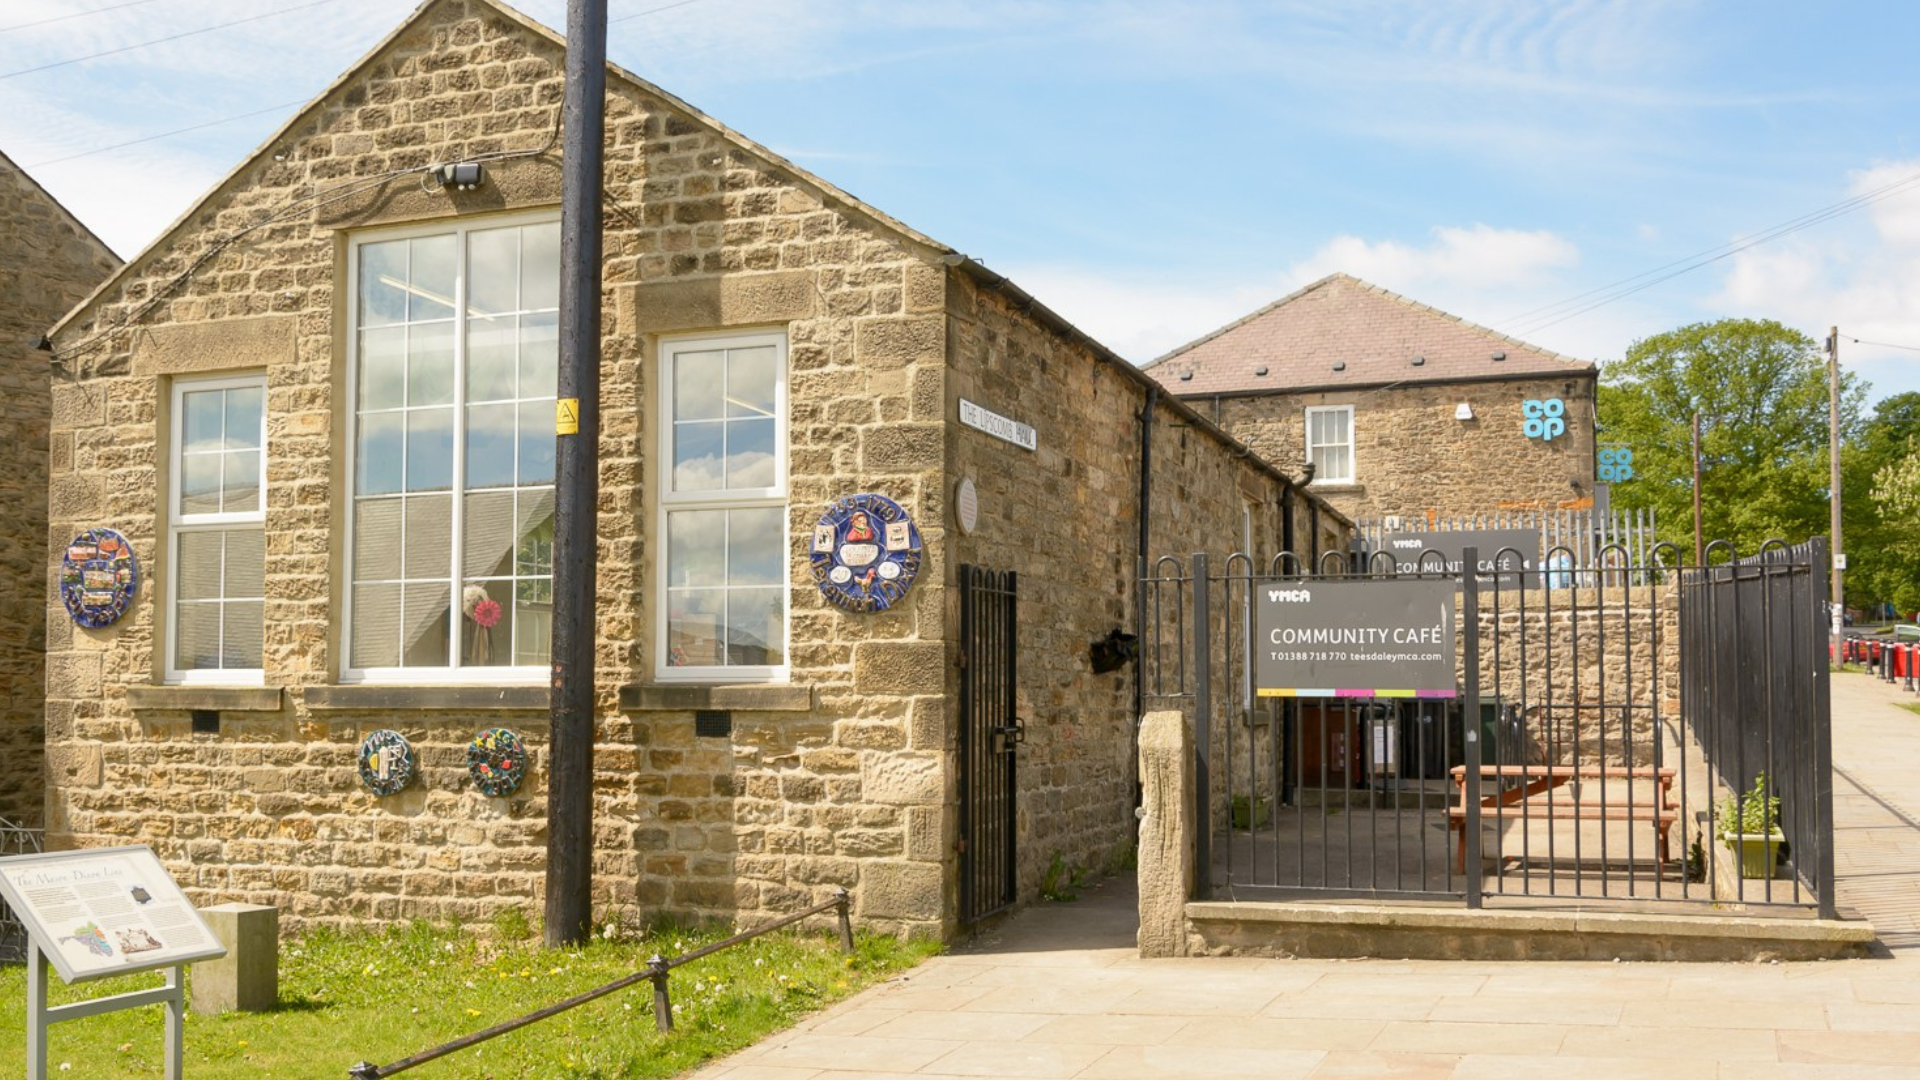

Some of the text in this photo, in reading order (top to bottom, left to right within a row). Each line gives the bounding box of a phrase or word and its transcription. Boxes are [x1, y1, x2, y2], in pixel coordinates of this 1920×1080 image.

[963, 402, 977, 425] THE
[1015, 423, 1034, 447] HALL
[1392, 539, 1422, 549] YMCA
[1268, 588, 1311, 603] YMCA
[1269, 624, 1442, 645] COMMUNITY CAFÉ
[1270, 651, 1442, 664] T 01388 718 770 teesdaleymca.com
